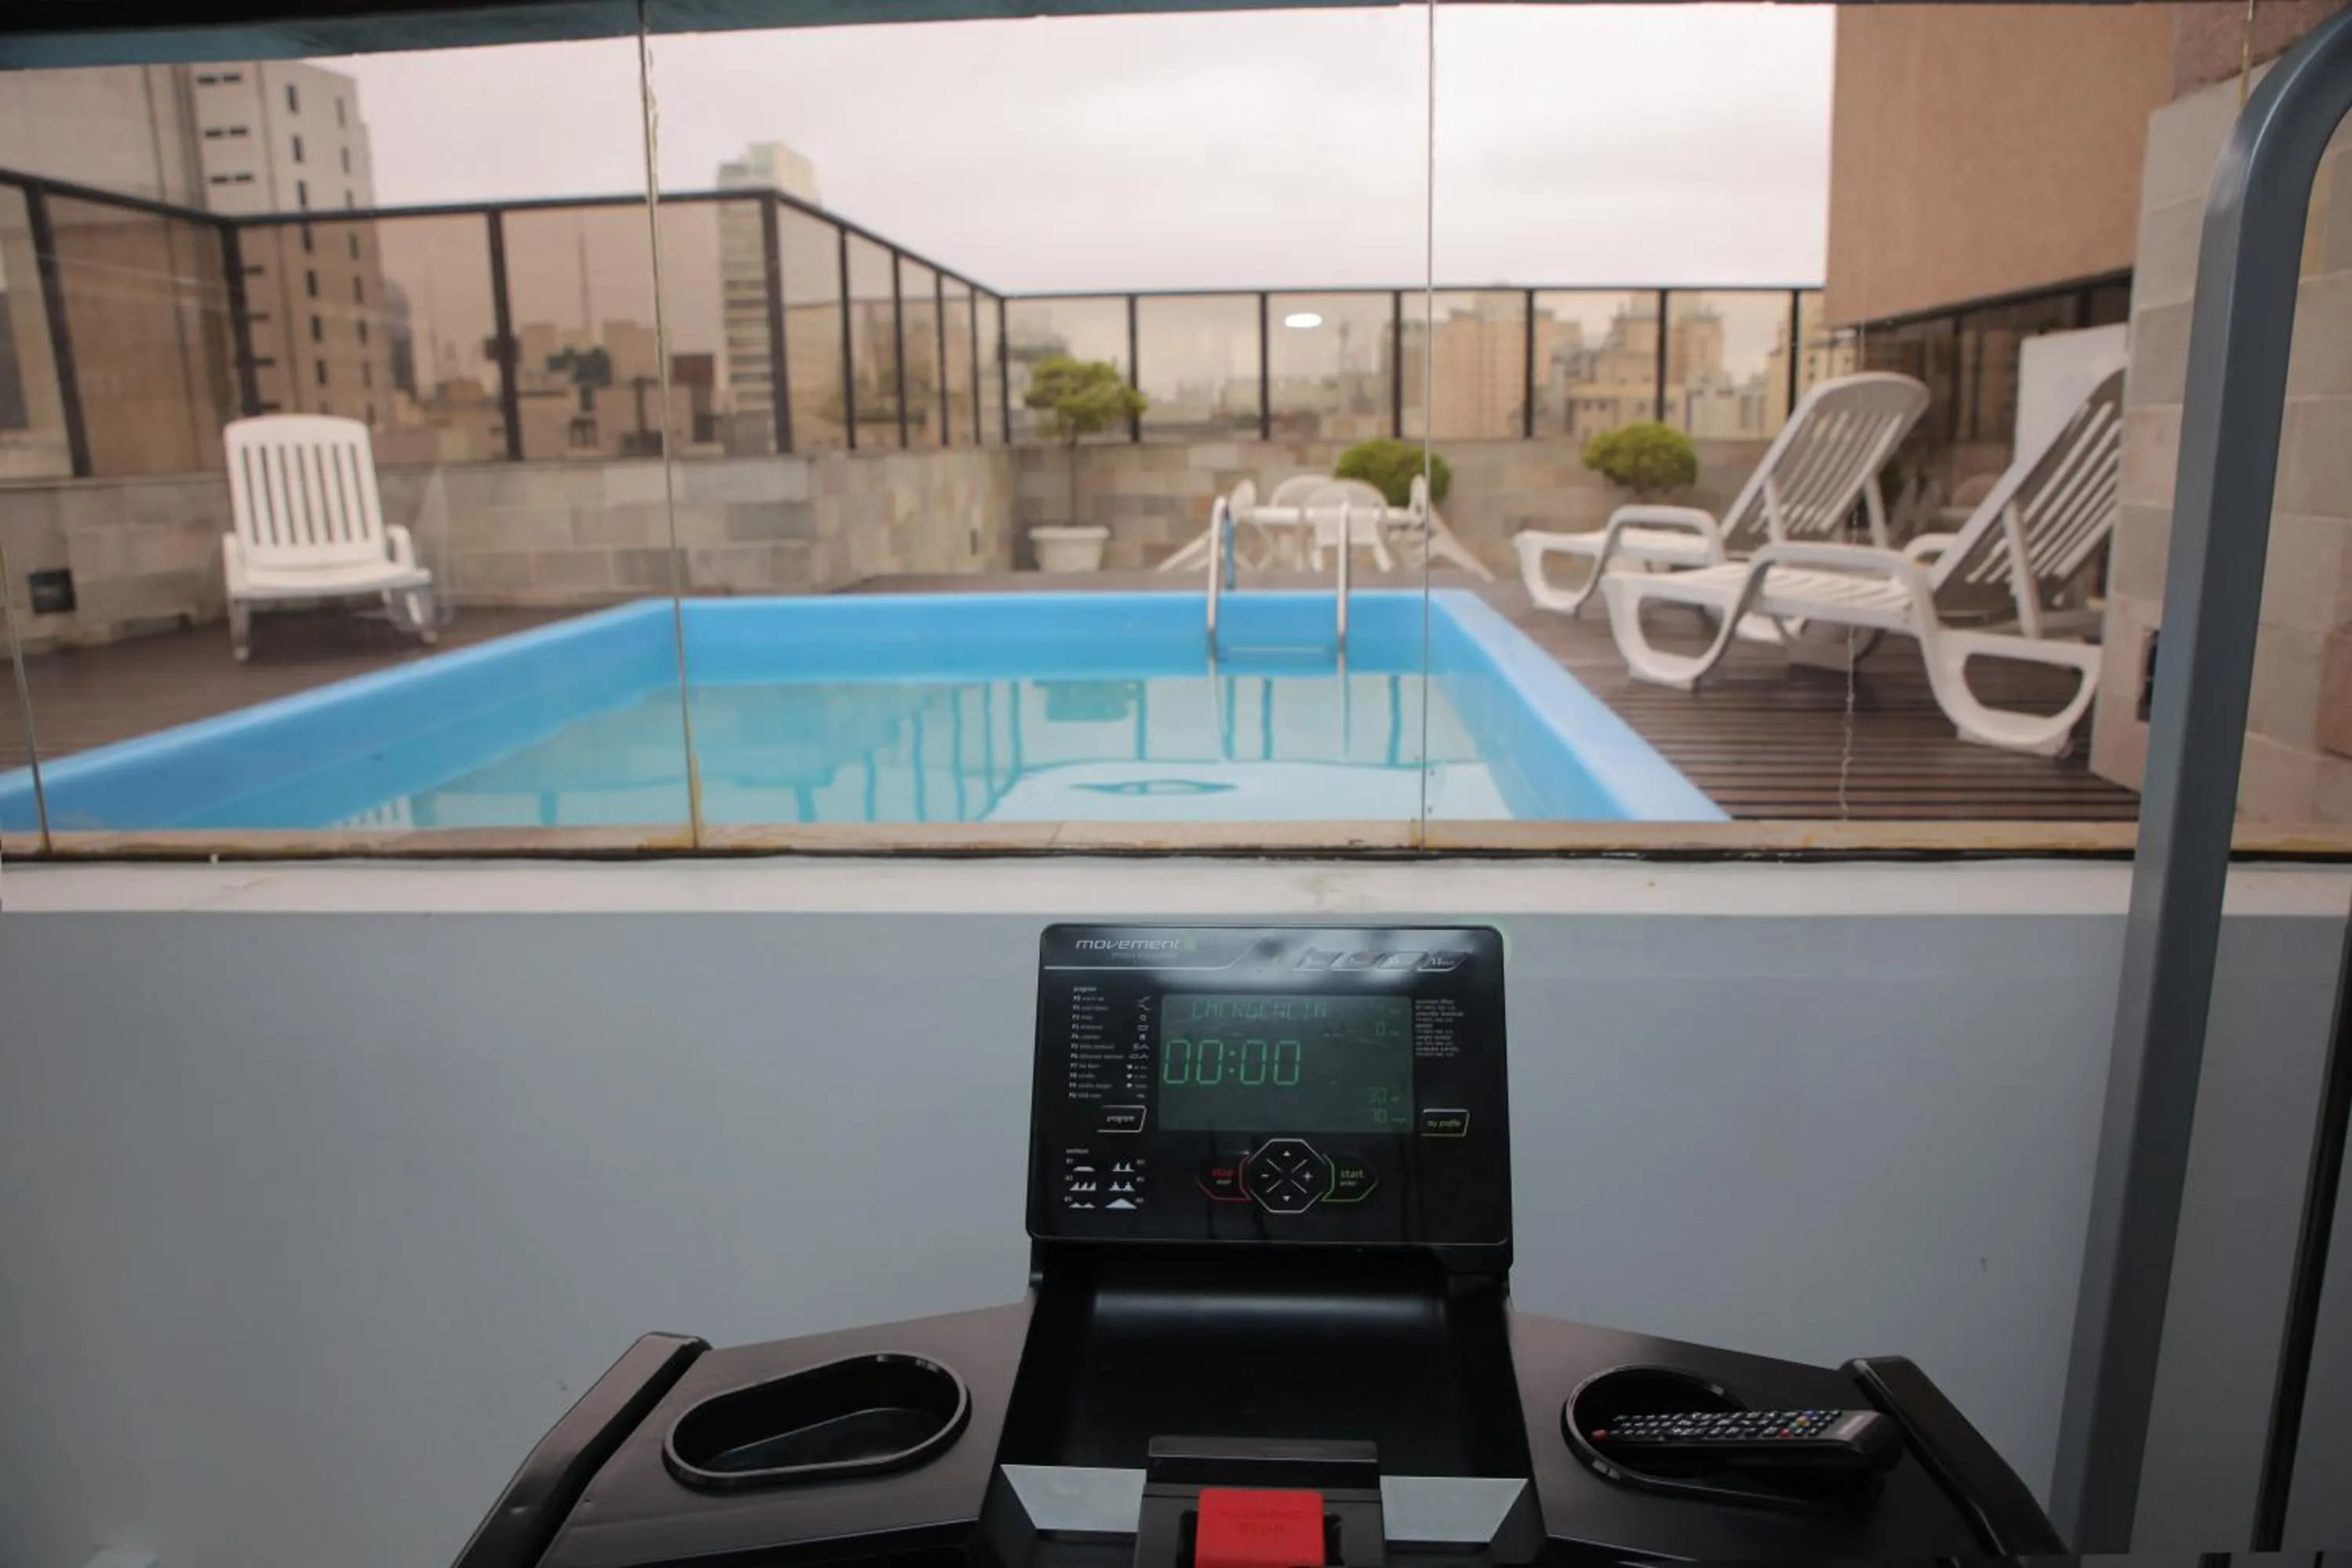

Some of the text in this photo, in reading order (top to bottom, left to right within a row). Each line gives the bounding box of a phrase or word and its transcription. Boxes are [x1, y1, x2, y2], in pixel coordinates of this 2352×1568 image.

[1075, 938, 1180, 950] movement
[1163, 1039, 1301, 1086] 00:00
[1106, 1116, 1135, 1124] program
[1340, 1169, 1365, 1180] start
